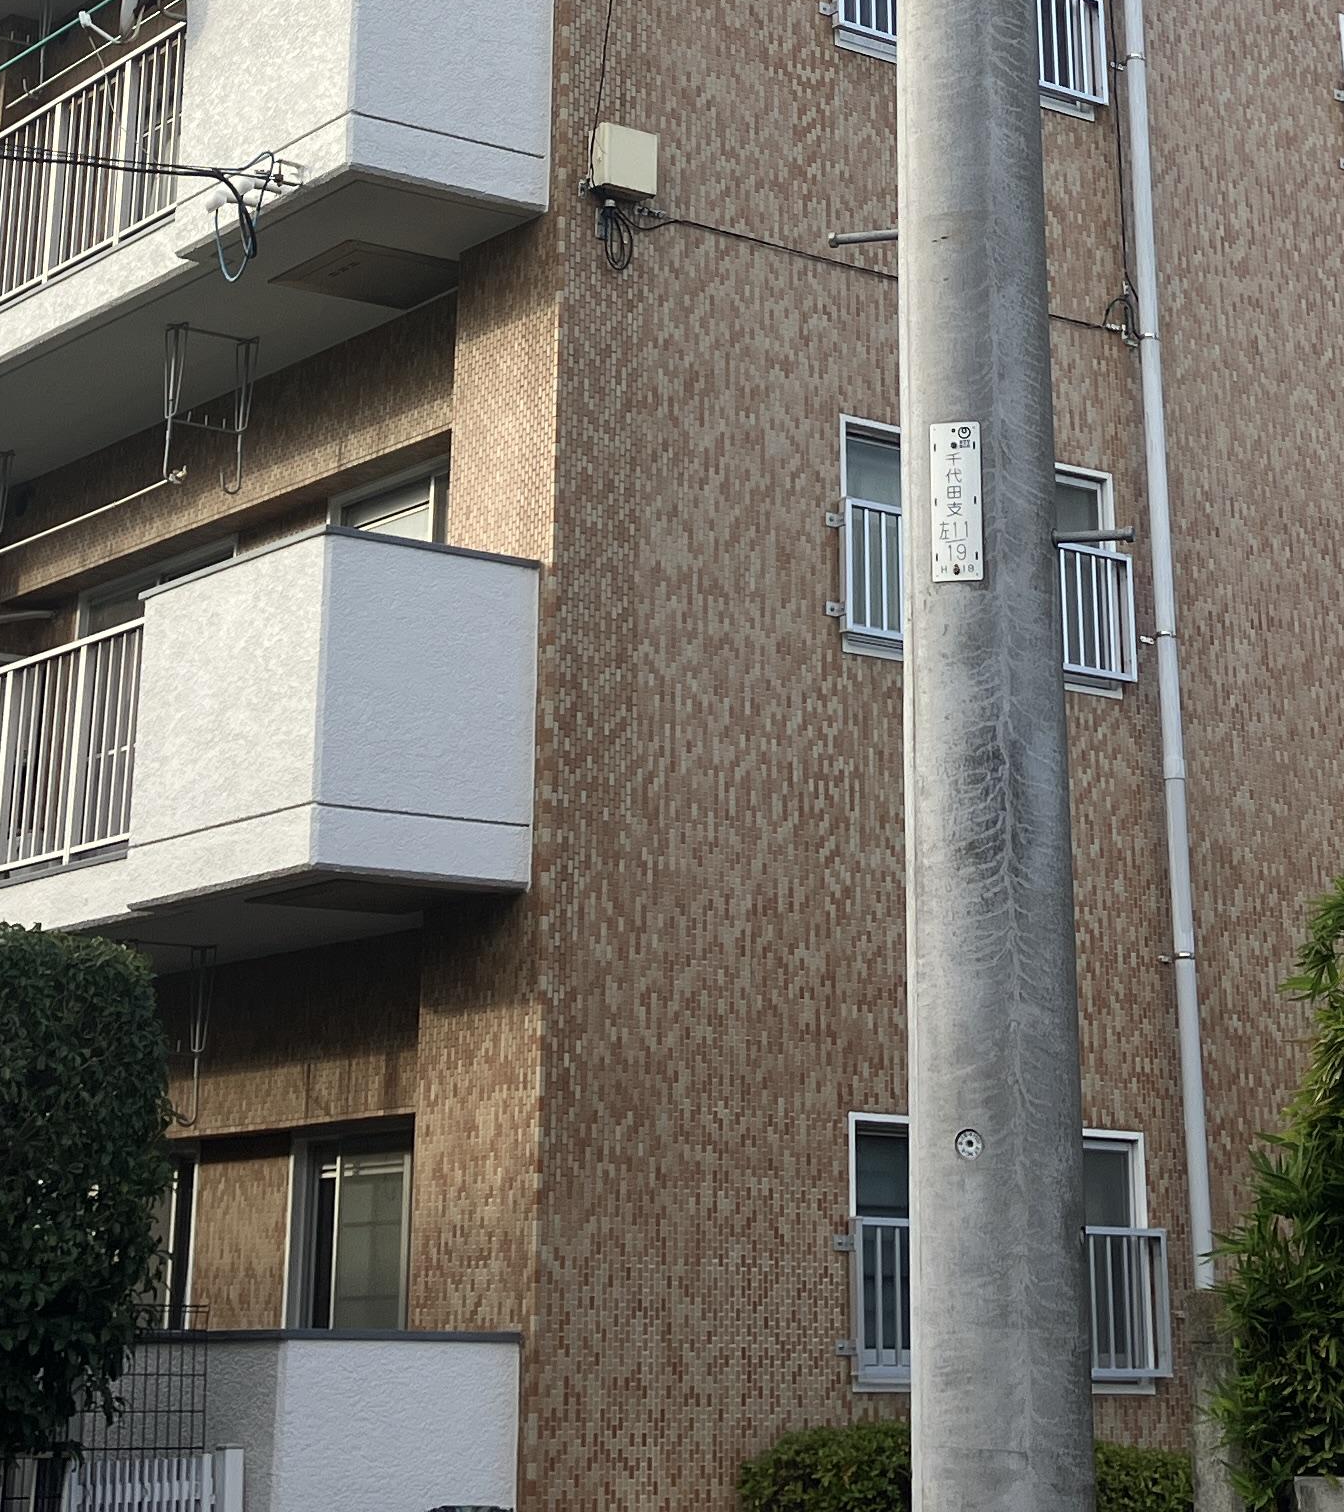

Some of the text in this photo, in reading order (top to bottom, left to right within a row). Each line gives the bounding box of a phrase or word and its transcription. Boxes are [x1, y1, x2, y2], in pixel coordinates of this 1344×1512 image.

[944, 452, 963, 517] 千代田支
[948, 544, 966, 560] 19
